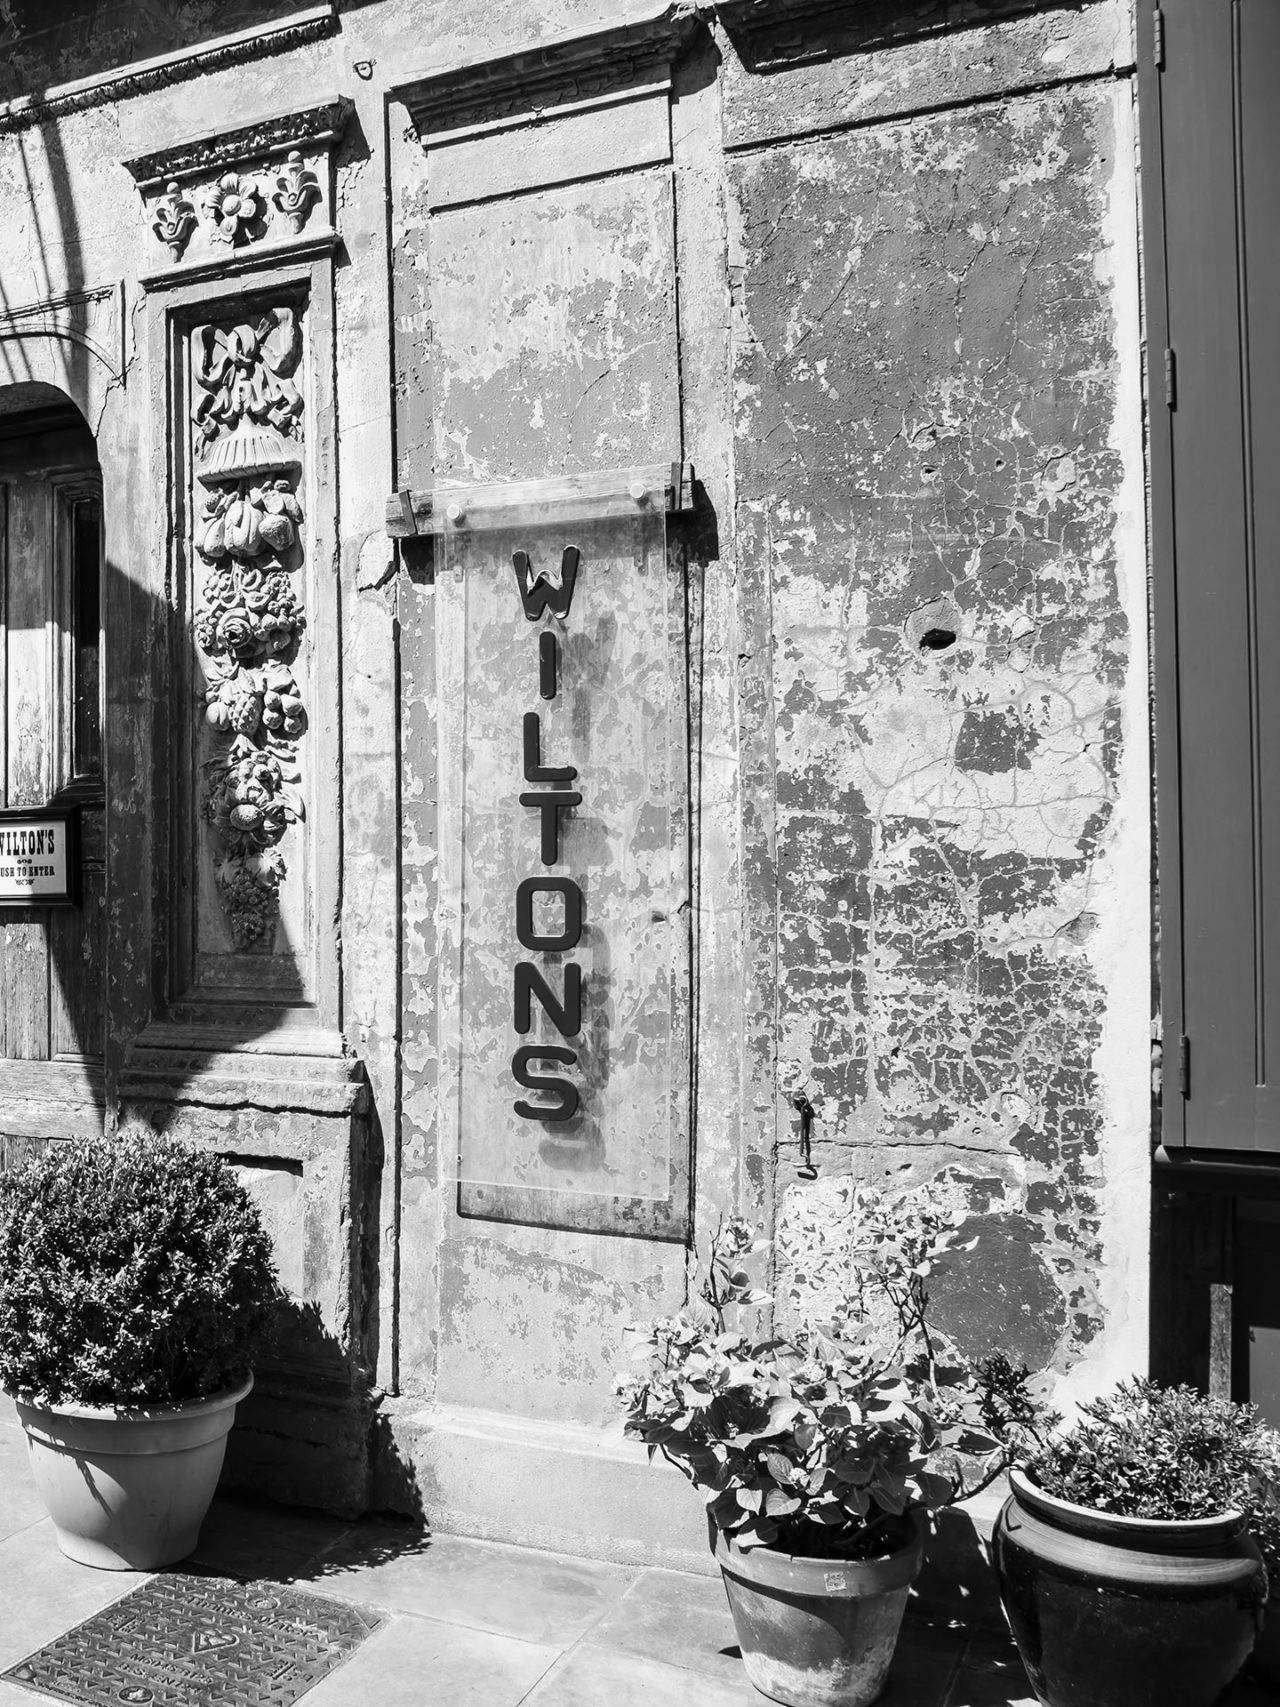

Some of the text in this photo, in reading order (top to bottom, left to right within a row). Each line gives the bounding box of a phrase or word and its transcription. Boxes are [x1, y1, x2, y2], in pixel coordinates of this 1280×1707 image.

[17, 866, 27, 877] TO
[28, 866, 55, 877] ENTER
[512, 545, 582, 1121] WILTONS
